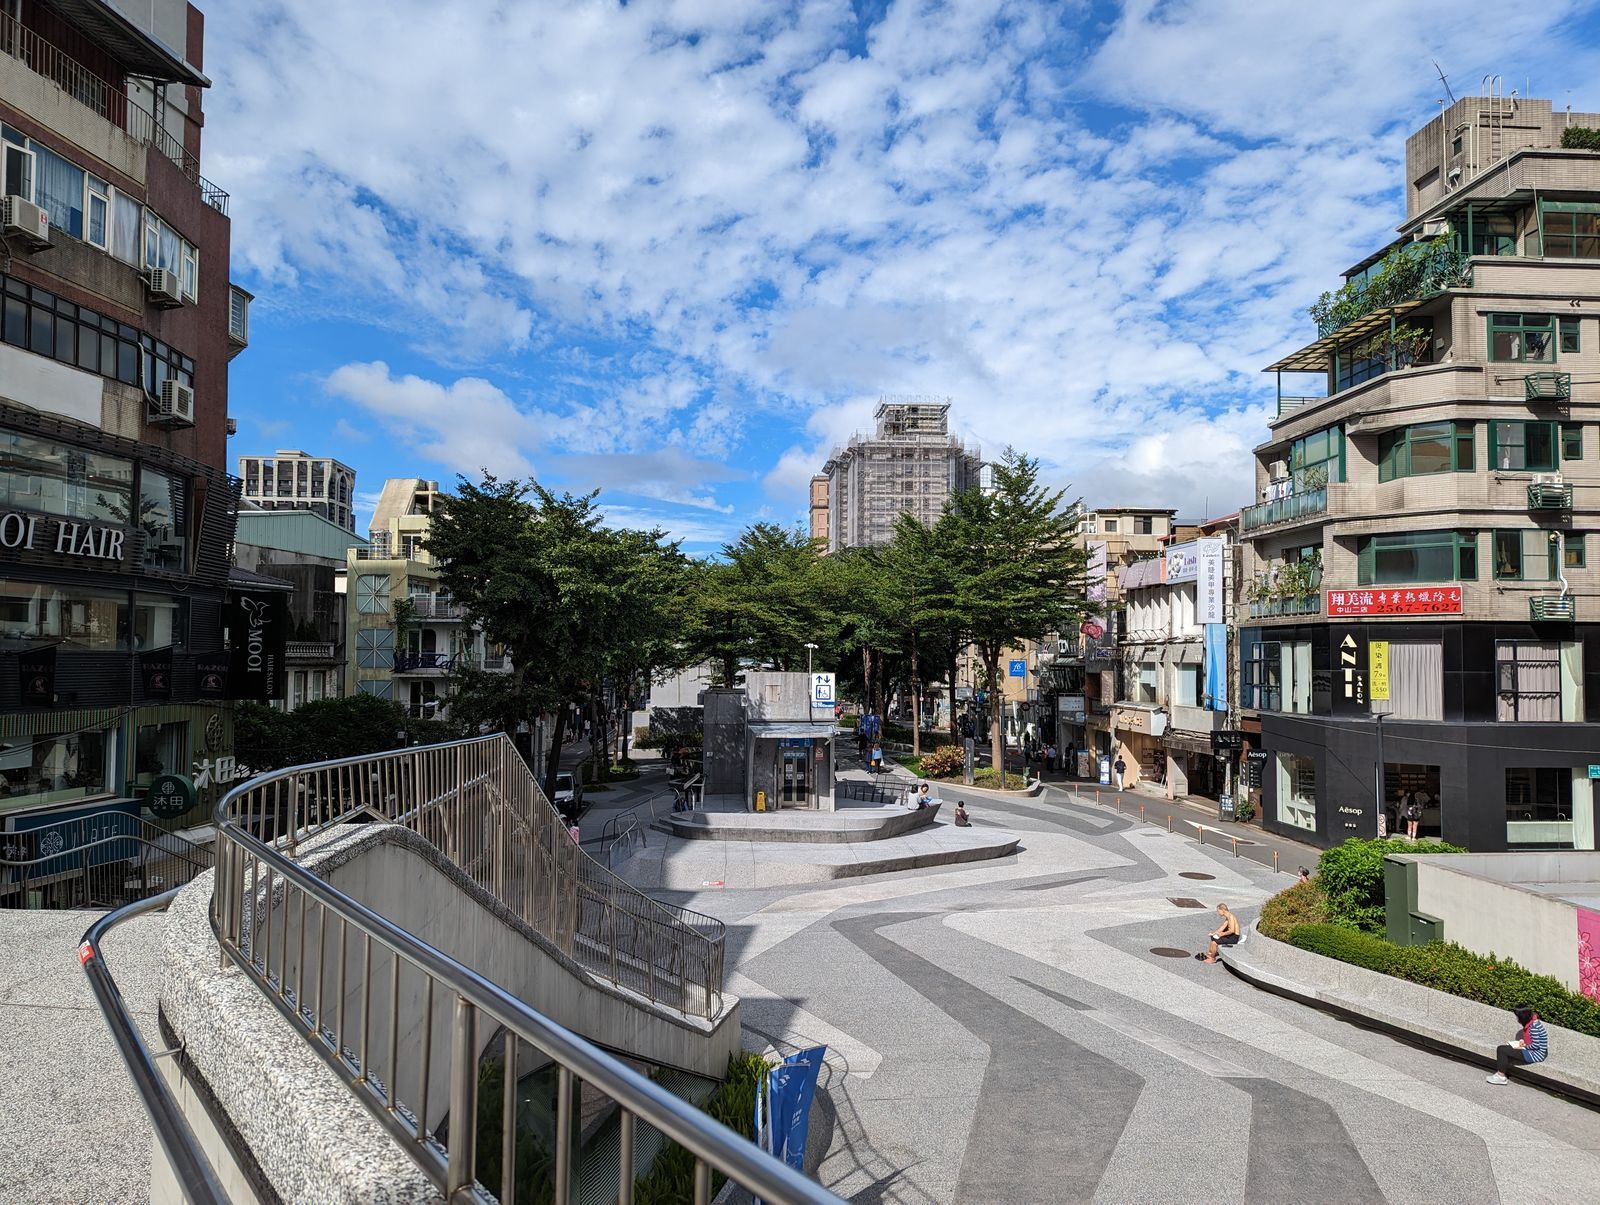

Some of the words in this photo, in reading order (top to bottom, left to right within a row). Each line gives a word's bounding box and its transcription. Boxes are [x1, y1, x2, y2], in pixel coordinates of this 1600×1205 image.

[55, 521, 124, 561] HAIR
[1331, 592, 1374, 606] 翔美流
[1377, 603, 1460, 613] 2567-7627
[1336, 606, 1368, 614] 中山二店
[247, 628, 263, 673] MOOI
[266, 654, 275, 672] HAIR
[1340, 633, 1358, 698] ANTI
[266, 672, 274, 695] SALON
[192, 756, 236, 793] 沐田
[153, 796, 184, 806] 沐田
